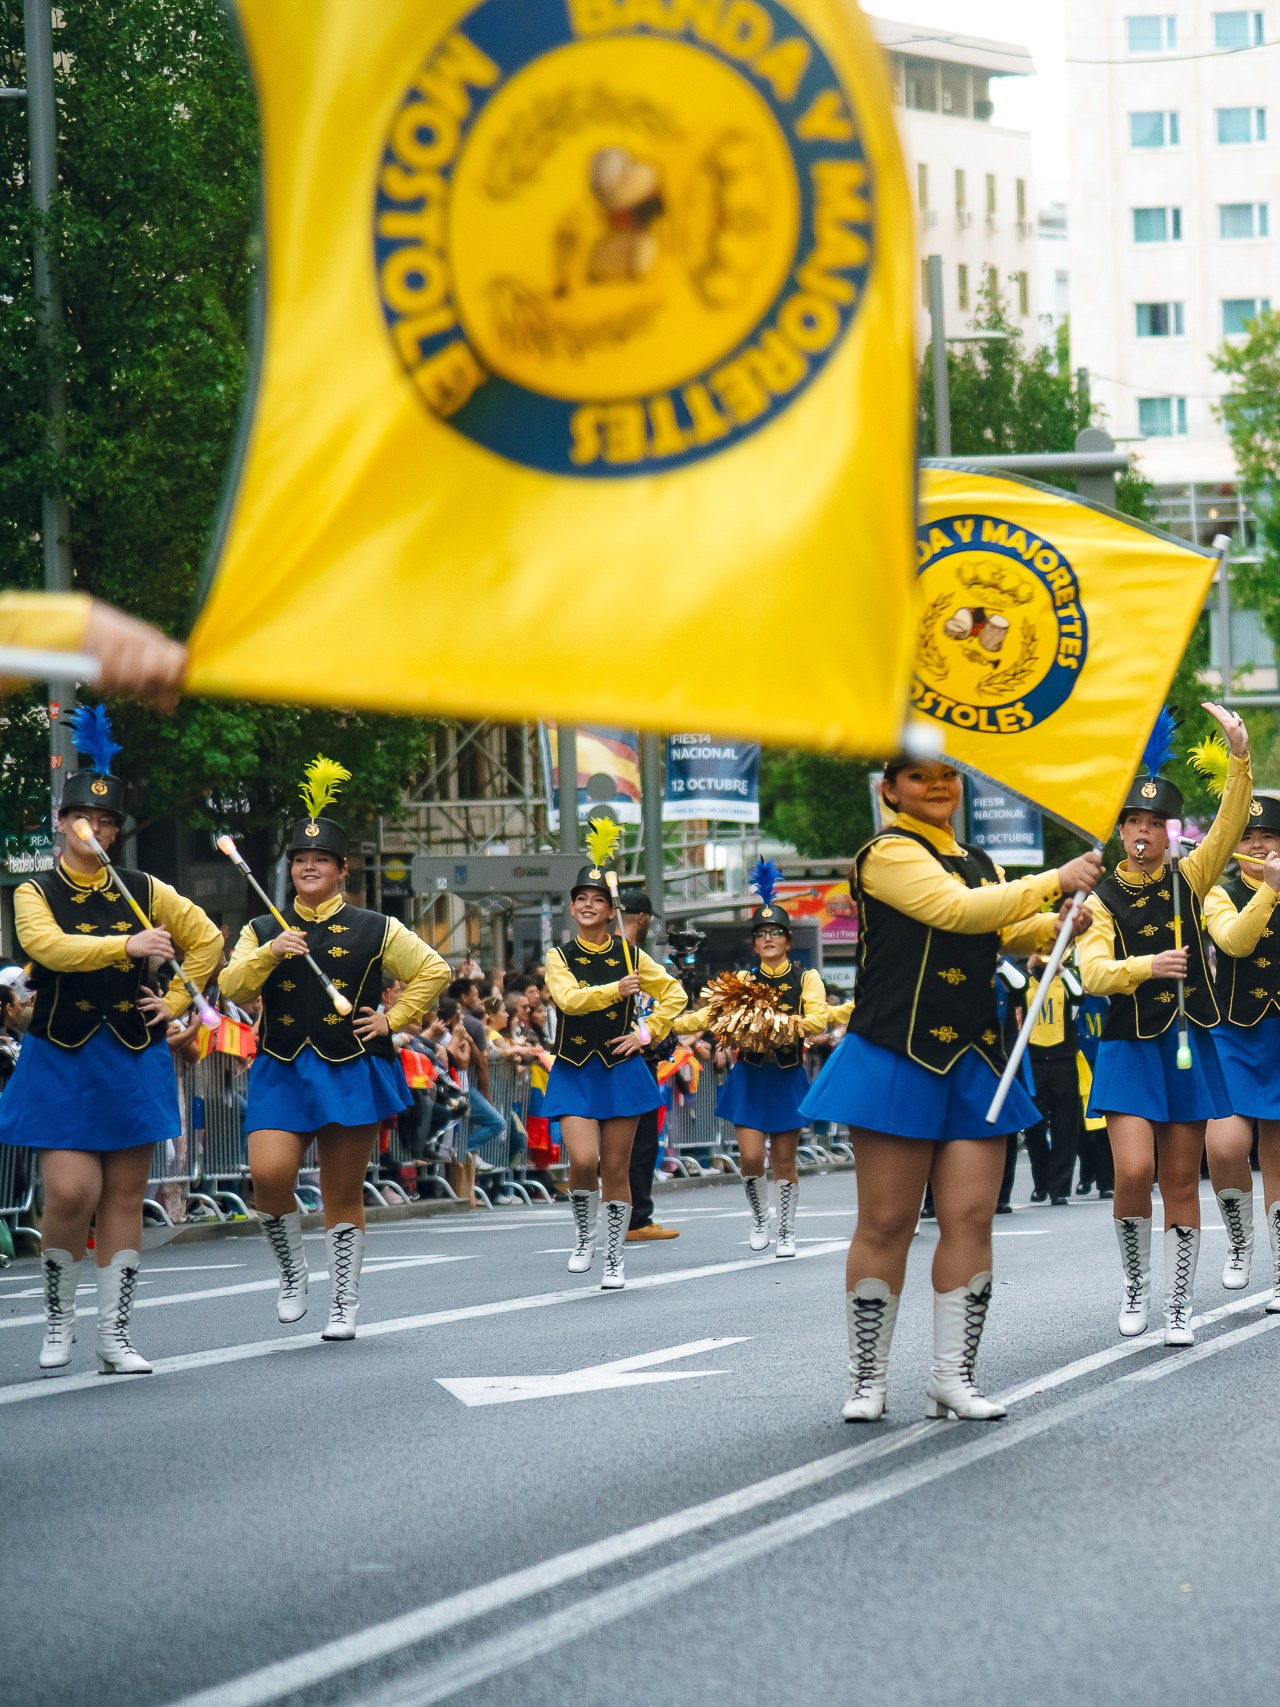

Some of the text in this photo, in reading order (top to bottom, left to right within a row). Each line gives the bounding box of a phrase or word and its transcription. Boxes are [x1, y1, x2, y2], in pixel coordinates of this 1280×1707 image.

[796, 90, 850, 141] Y
[570, 158, 867, 466] MAJORETTES
[953, 518, 975, 543] Y
[981, 519, 1084, 671] MAJORETTES
[908, 679, 1034, 734] OSTOLES
[671, 733, 712, 745] FIESTA
[671, 747, 739, 761] NACIONAL
[671, 778, 748, 796] 12 OCTUBRE
[974, 797, 1005, 807] FIESTA
[975, 808, 1025, 820] NACIONAL
[976, 832, 1035, 845] 12 OCTUBRE
[822, 930, 836, 938] cial
[1037, 997, 1054, 1025] M
[1085, 1012, 1102, 1037] M
